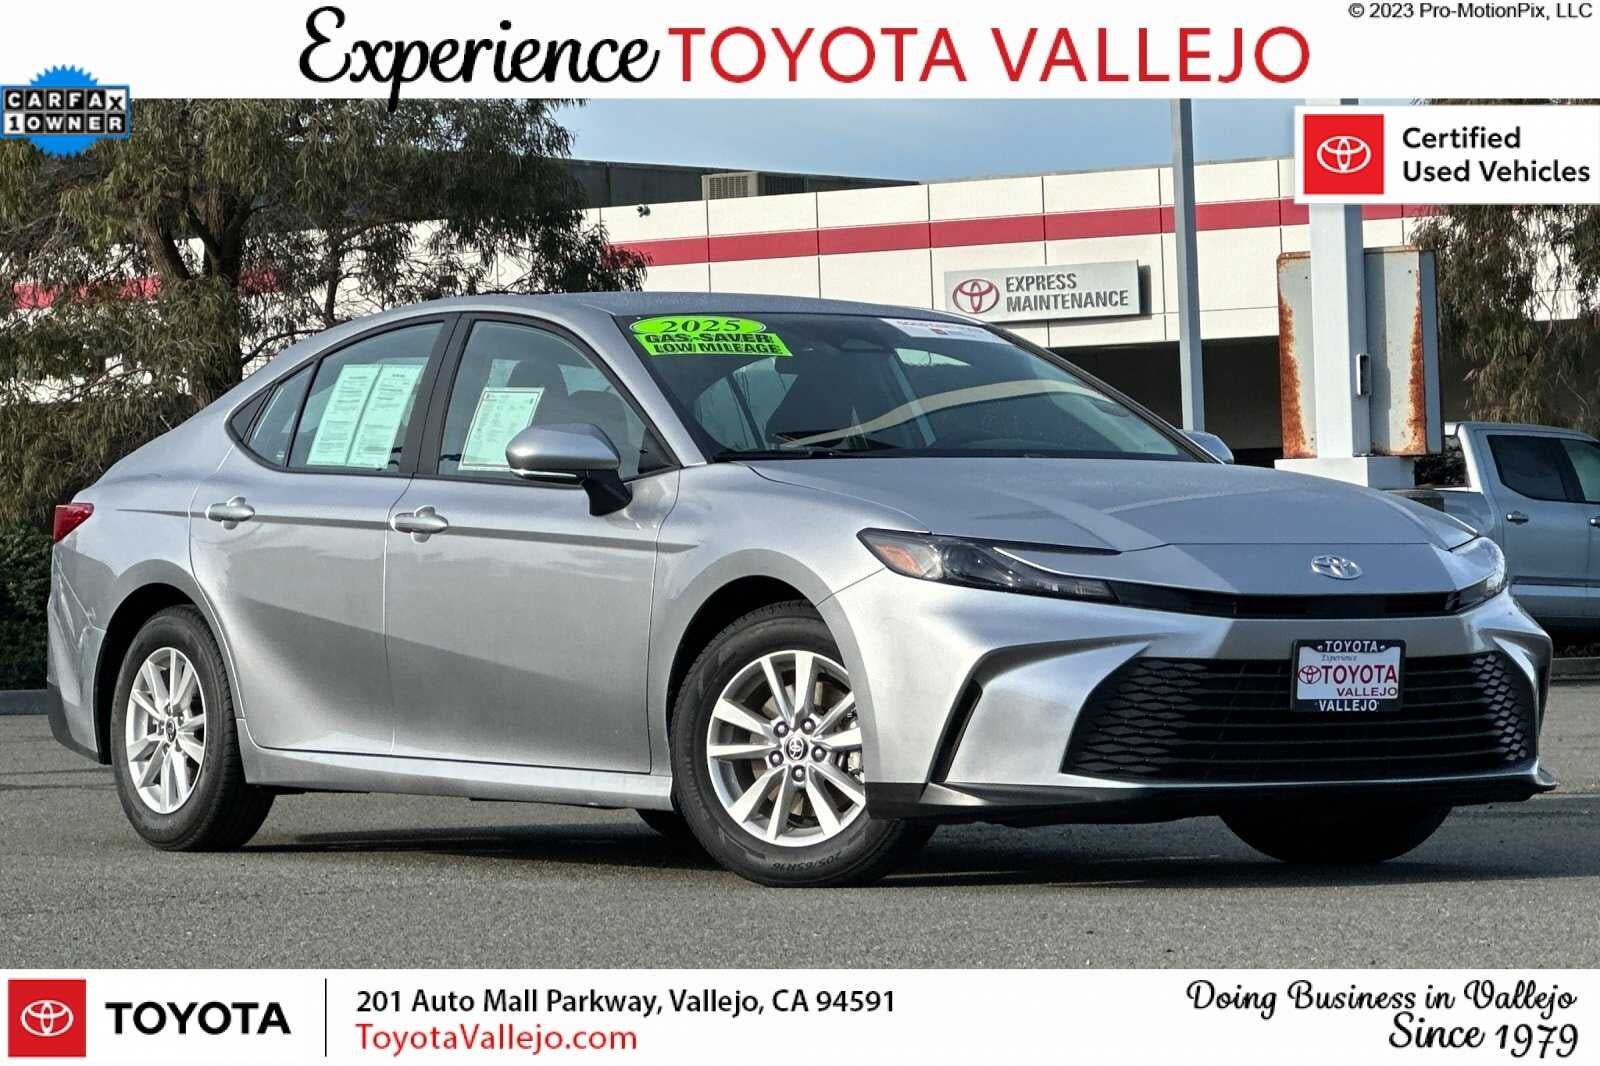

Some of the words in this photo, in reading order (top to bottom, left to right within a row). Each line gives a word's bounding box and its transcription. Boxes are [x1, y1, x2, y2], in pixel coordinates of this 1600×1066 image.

[1006, 273, 1077, 293] EXPRESS
[1006, 290, 1129, 312] MAINTENANCE
[660, 319, 741, 333] 2025
[654, 343, 694, 353] LOW
[700, 343, 783, 354] MILEAGE
[1325, 640, 1378, 652] TOYOTA
[1321, 664, 1398, 685] TOYOTA
[1337, 687, 1398, 697] VALLEJO
[1319, 700, 1378, 712] VALLEJO
